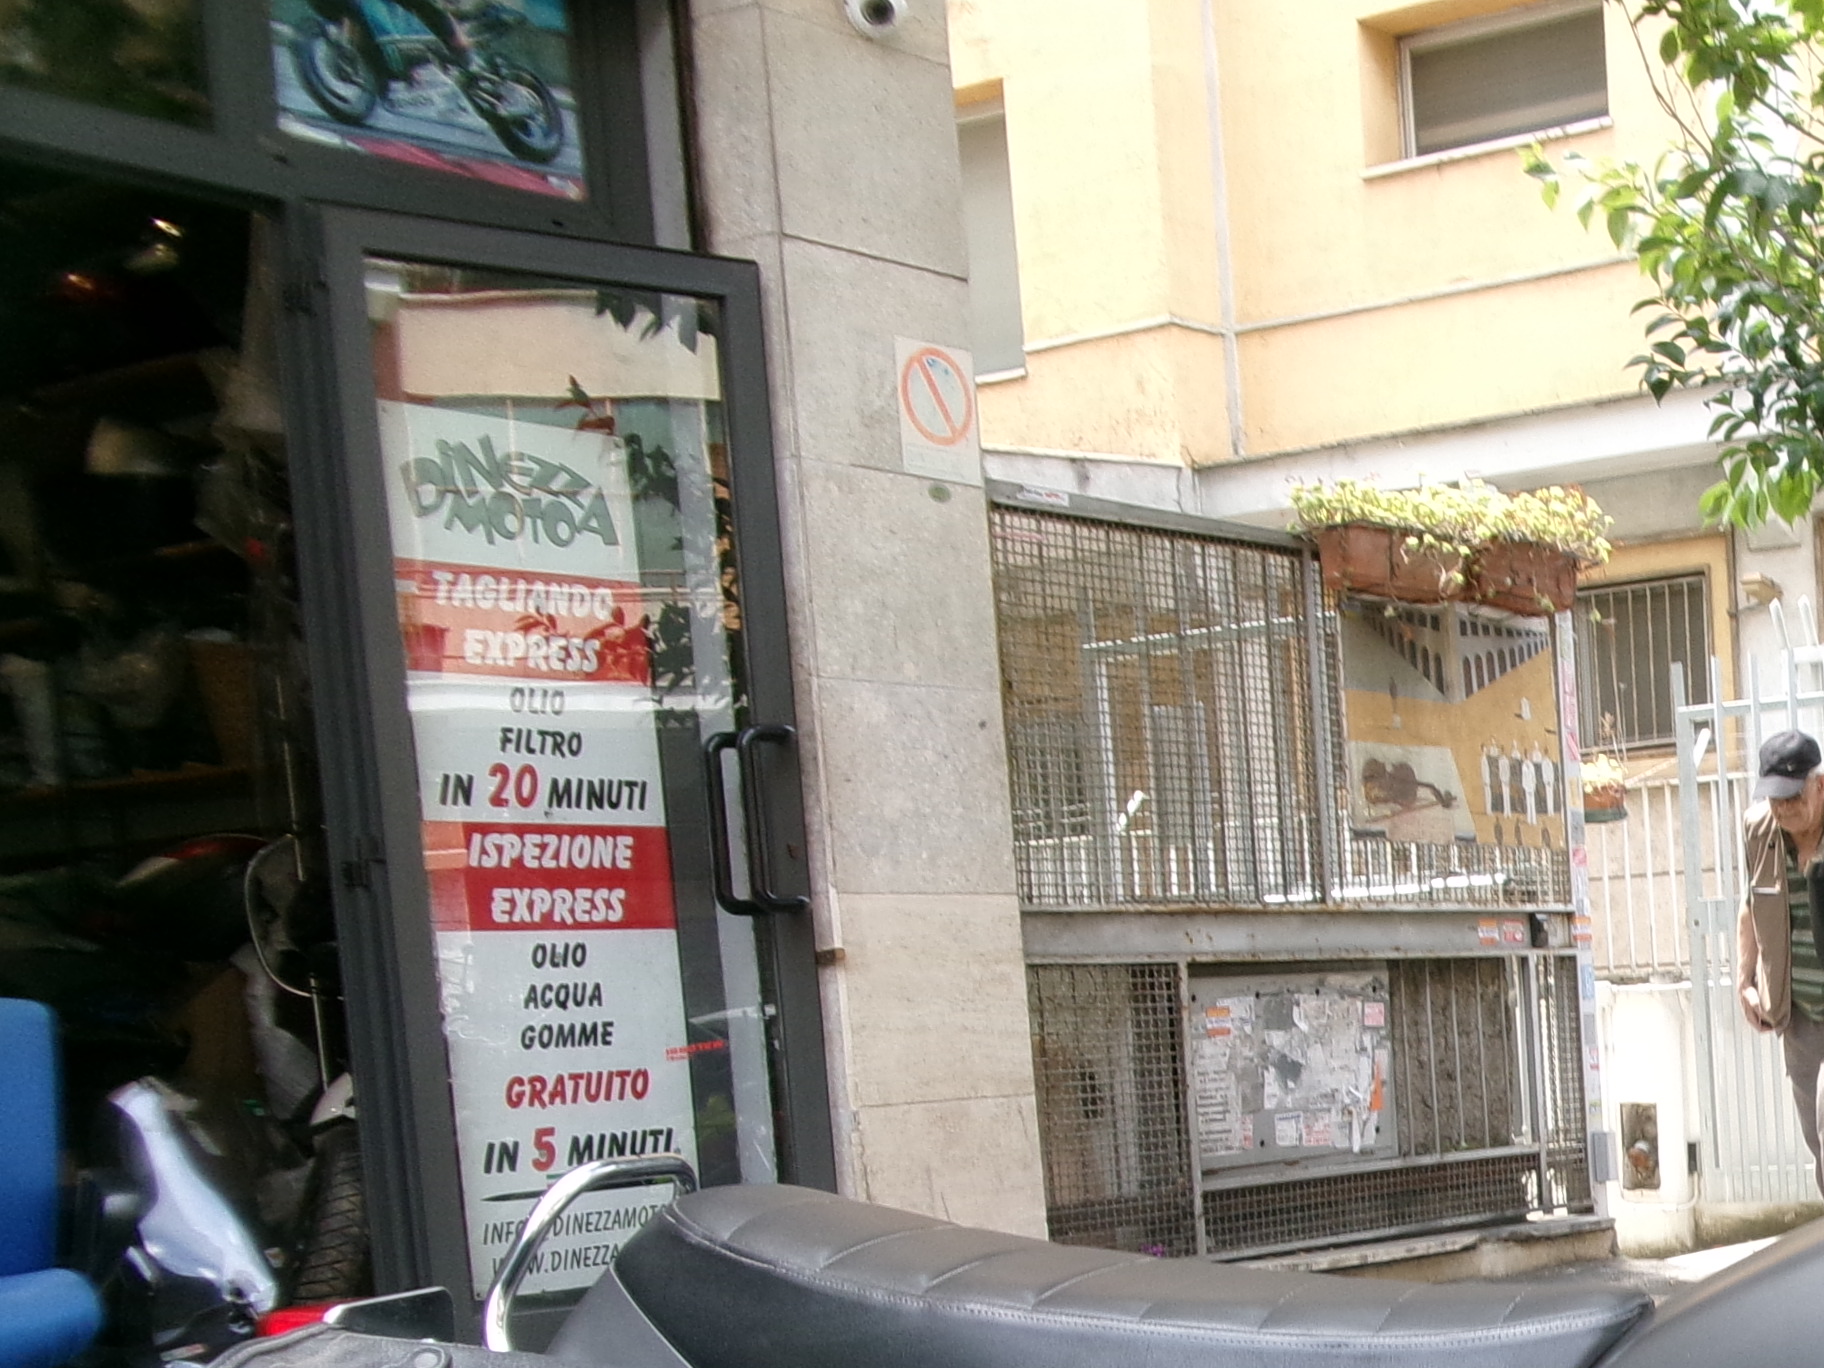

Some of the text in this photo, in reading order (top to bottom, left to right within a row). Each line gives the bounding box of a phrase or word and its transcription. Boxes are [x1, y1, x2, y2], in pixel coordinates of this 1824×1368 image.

[432, 570, 613, 617] TAGLIANDO
[464, 629, 601, 673] EXPRESS
[511, 687, 566, 716] OLIO
[499, 726, 583, 756] FILTRO
[439, 763, 648, 811] IN 20 MINUTI
[469, 833, 634, 869] ISPEZIONE
[491, 887, 626, 925] EXPRESS
[531, 942, 587, 969] OLIO
[523, 982, 604, 1010] ACQUA
[520, 1021, 615, 1050] GOMME
[505, 1068, 650, 1110] GRATUITO
[483, 1126, 675, 1174] IN 5 MINUTI
